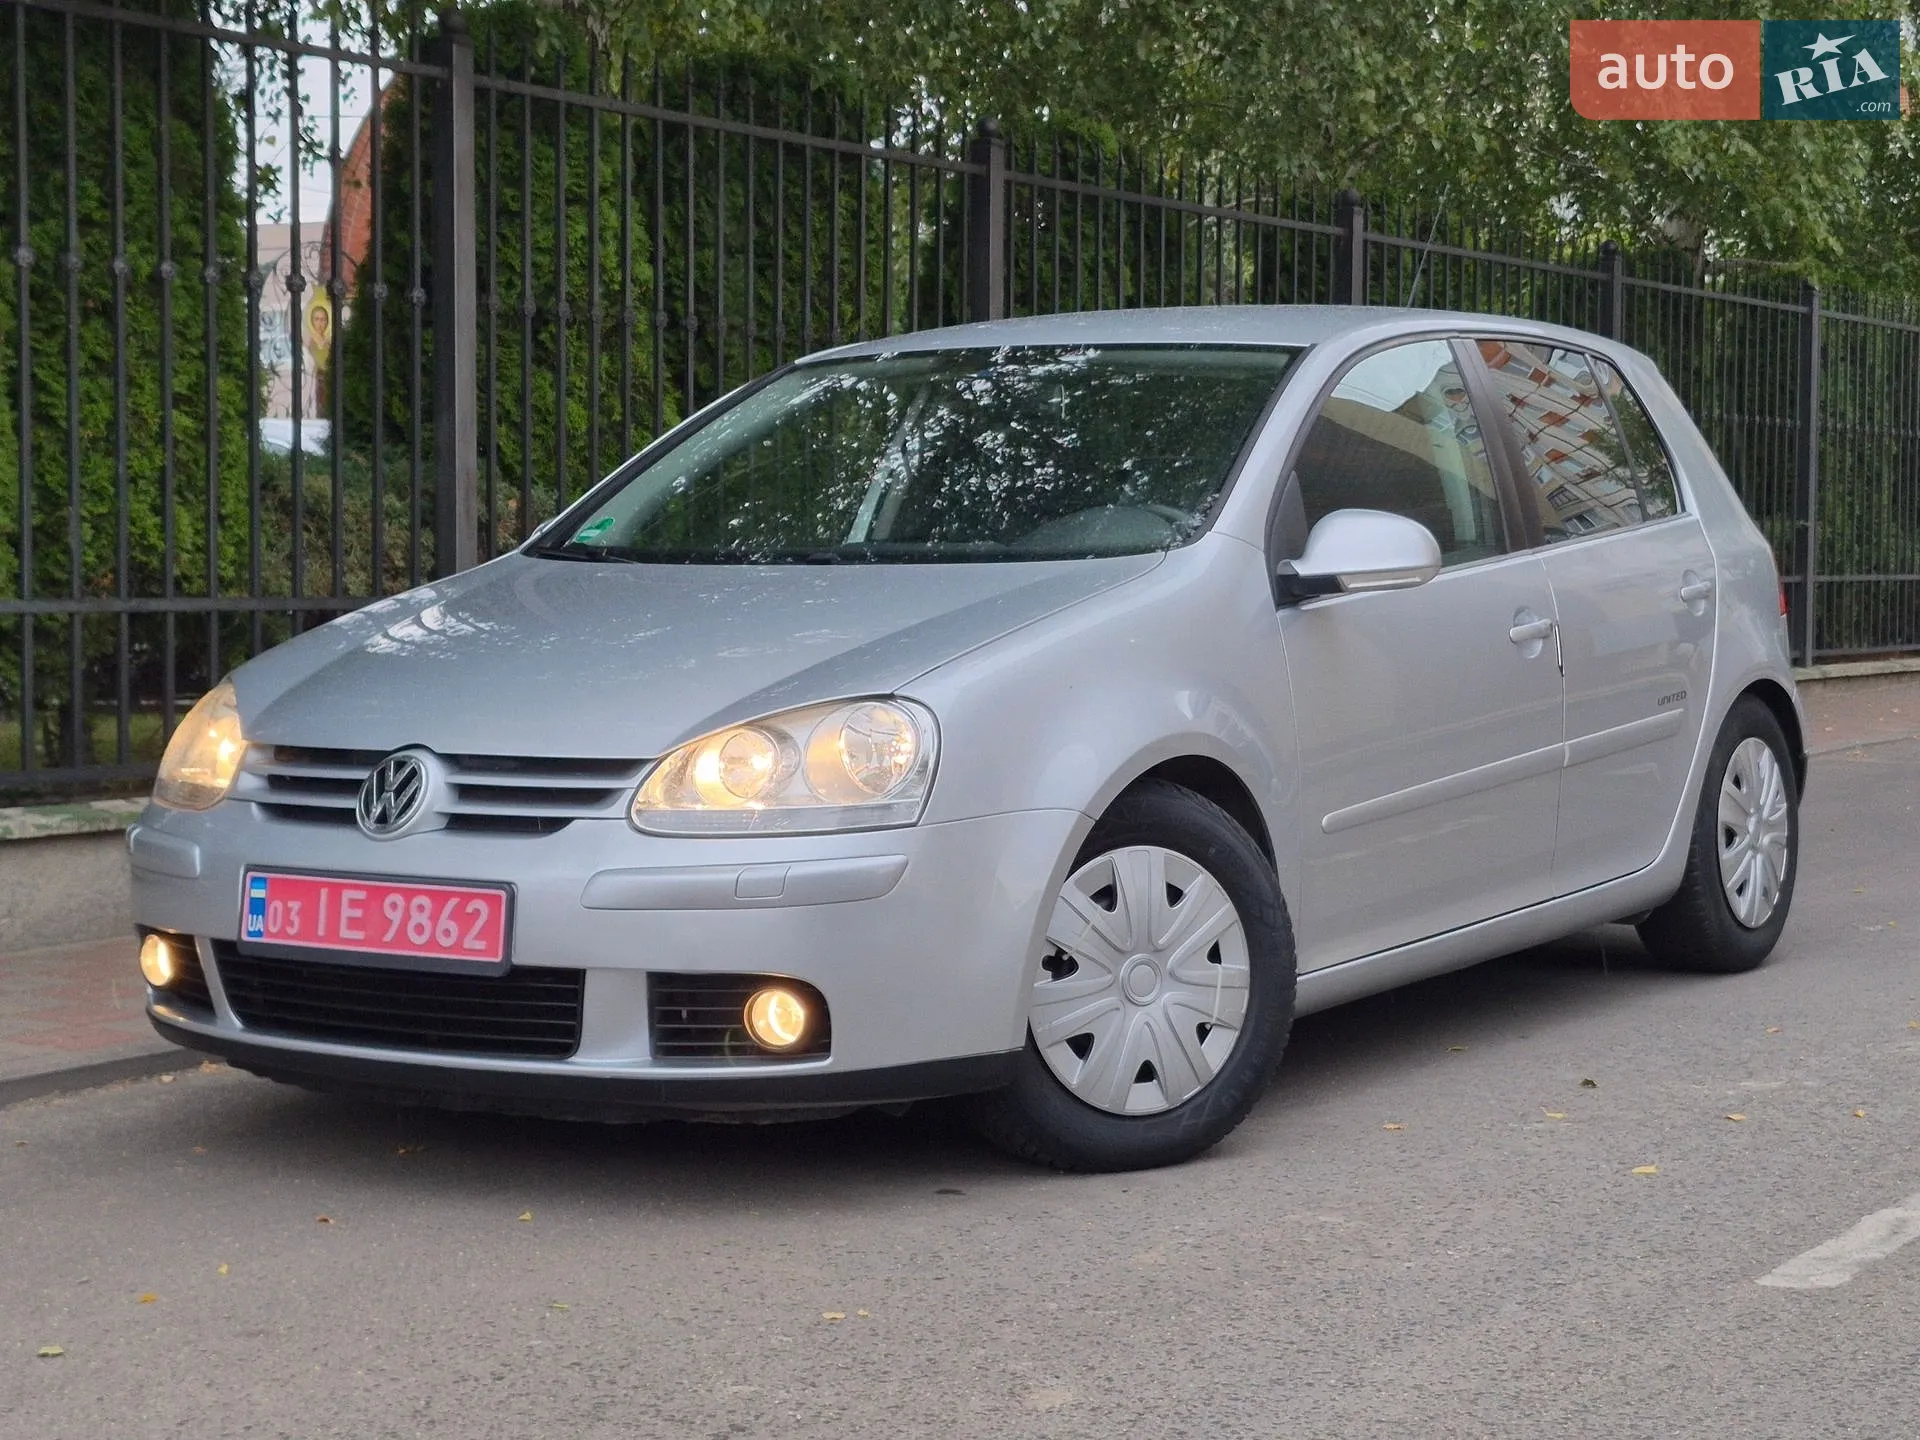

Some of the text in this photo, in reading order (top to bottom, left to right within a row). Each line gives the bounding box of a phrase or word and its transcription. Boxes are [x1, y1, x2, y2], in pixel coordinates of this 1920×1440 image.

[1657, 690, 1687, 706] UNITED
[247, 913, 264, 932] UA
[267, 888, 490, 950] 03 IE 9862
